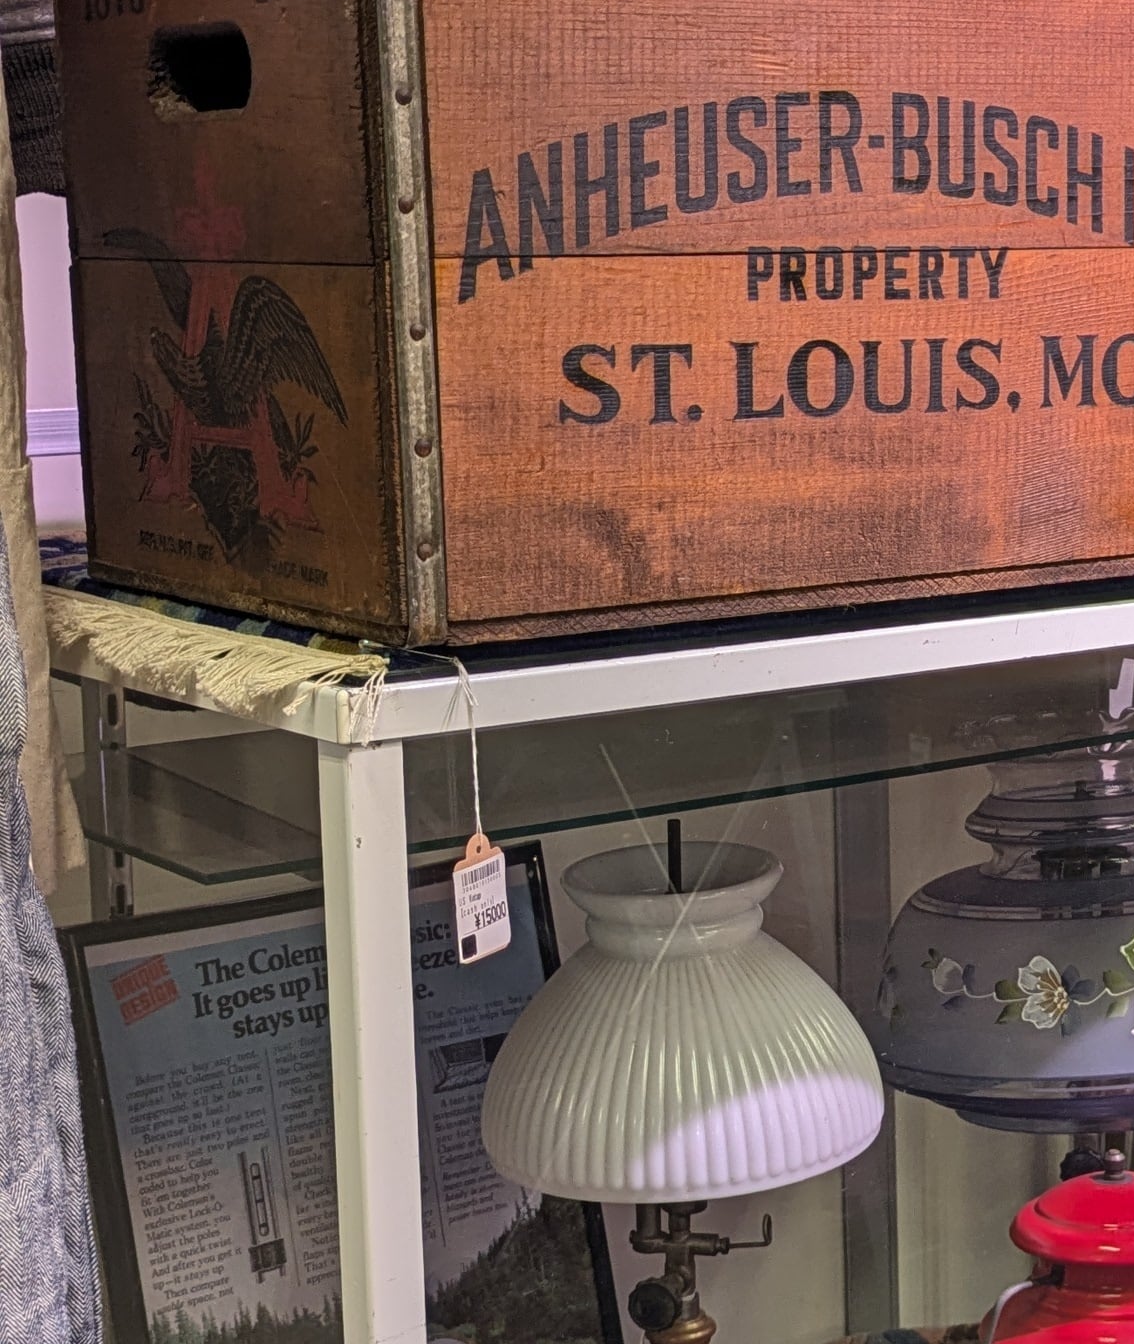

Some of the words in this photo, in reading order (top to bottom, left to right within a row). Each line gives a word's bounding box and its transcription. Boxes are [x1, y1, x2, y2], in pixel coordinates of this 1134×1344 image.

[456, 90, 1104, 305] ANHEUSER-BUSCH
[746, 246, 1008, 302] PROPERTY
[558, 343, 705, 426] ST.
[730, 336, 1021, 422] LOUIS,
[474, 901, 506, 930] ¥15000
[195, 959, 245, 986] The
[248, 944, 327, 974] Colem
[415, 921, 451, 945] sic:
[119, 978, 179, 1023] DESIGN
[192, 991, 212, 1018] It
[216, 983, 276, 1019] goes
[280, 977, 311, 1002] up
[233, 1007, 294, 1039] stays
[167, 1079, 182, 1090] the
[185, 1070, 224, 1085] Coleman
[144, 1128, 184, 1144] Because
[188, 1122, 207, 1133] this
[224, 1114, 242, 1124] one
[134, 1145, 163, 1159] that's
[200, 1130, 222, 1142] easy
[135, 1158, 162, 1171] There
[166, 1154, 182, 1162] are
[207, 1143, 224, 1153] two
[227, 1137, 250, 1150] poles
[253, 1128, 270, 1140] and
[188, 1158, 213, 1170] Color
[439, 1152, 474, 1166] Coleman
[138, 1182, 166, 1195] coded
[166, 1179, 178, 1187] to
[180, 1173, 201, 1184] help
[202, 1168, 220, 1181] you
[142, 1205, 166, 1218] With
[144, 1214, 187, 1231] exclusive
[214, 1215, 232, 1227] you
[148, 1240, 176, 1254] adjust
[179, 1233, 196, 1246] the
[197, 1228, 221, 1244] poles
[150, 1254, 170, 1266] with
[180, 1246, 206, 1260] quick
[152, 1264, 170, 1278] And
[172, 1260, 196, 1272] after
[198, 1257, 216, 1268] you
[218, 1250, 233, 1262] get
[164, 1288, 188, 1300] Then
[190, 1276, 230, 1294] compare
[184, 1270, 210, 1282] stays
[218, 1286, 235, 1298] not
